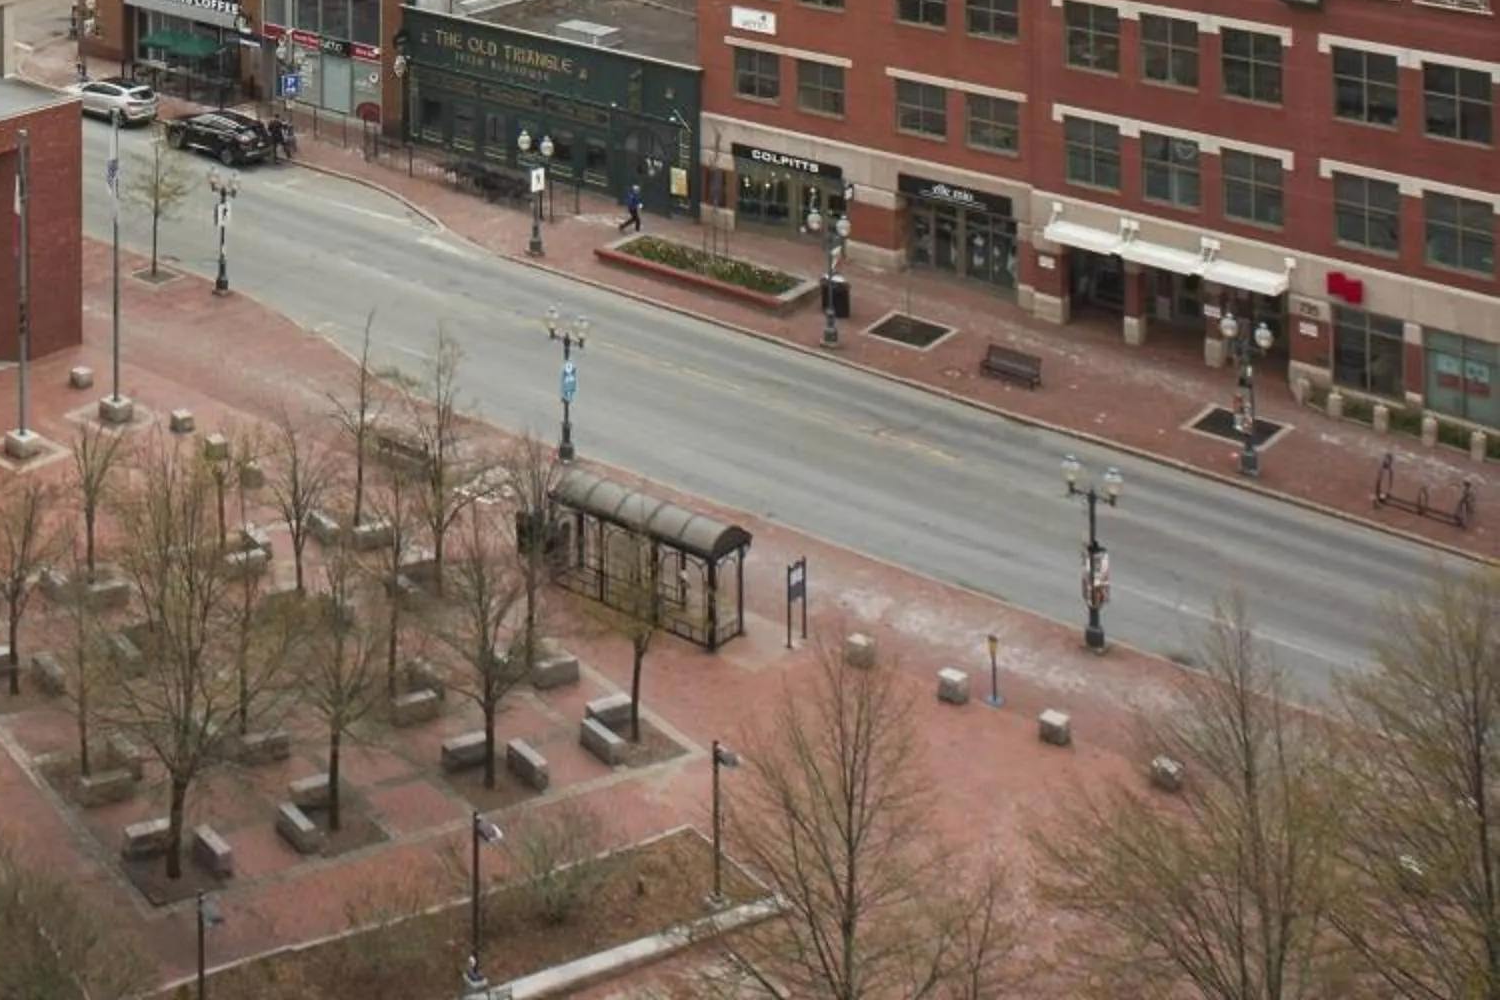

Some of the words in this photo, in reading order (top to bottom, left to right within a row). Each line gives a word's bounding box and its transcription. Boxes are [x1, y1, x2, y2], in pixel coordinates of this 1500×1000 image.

[436, 29, 463, 50] THE
[467, 37, 497, 58] OLD
[503, 44, 573, 75] TRIANGLE
[751, 149, 819, 173] COLPITTS
